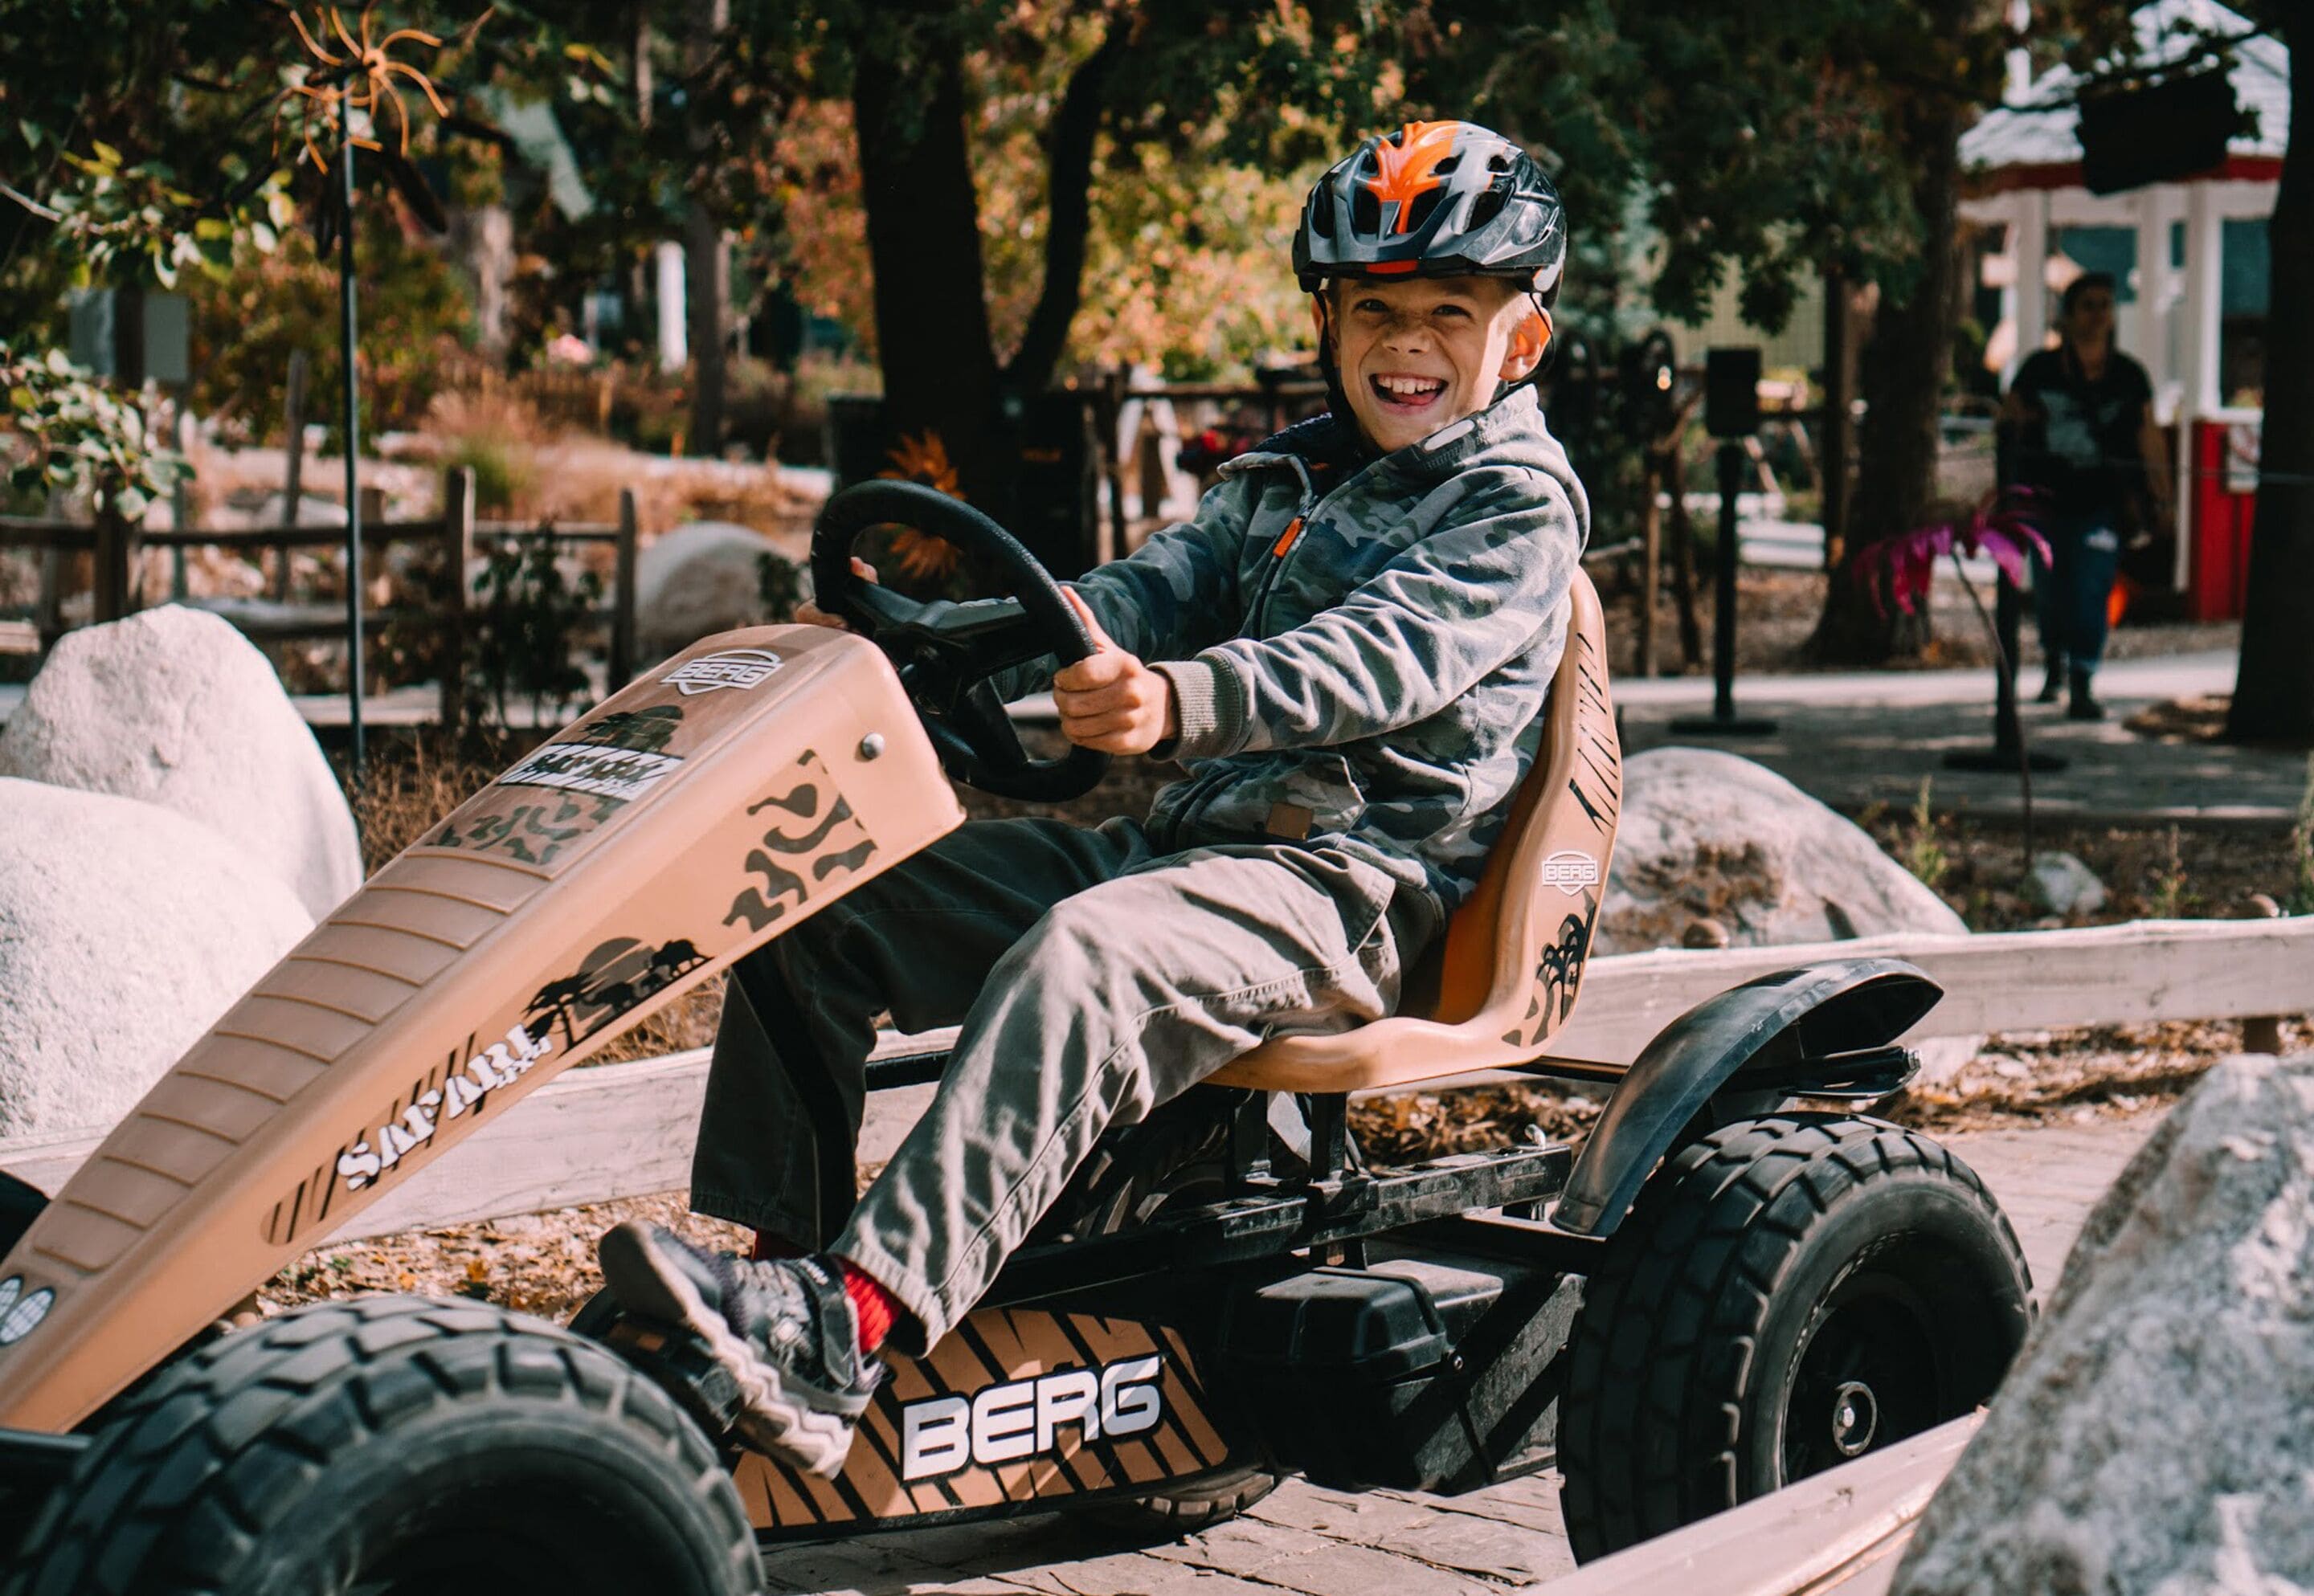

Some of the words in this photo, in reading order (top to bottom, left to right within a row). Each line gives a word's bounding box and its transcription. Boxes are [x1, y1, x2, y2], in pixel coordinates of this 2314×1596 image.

[670, 662, 773, 683] BERG
[1544, 864, 1596, 881] BERG
[337, 1023, 538, 1191] SAFARI
[902, 1356, 1161, 1480] BERG
